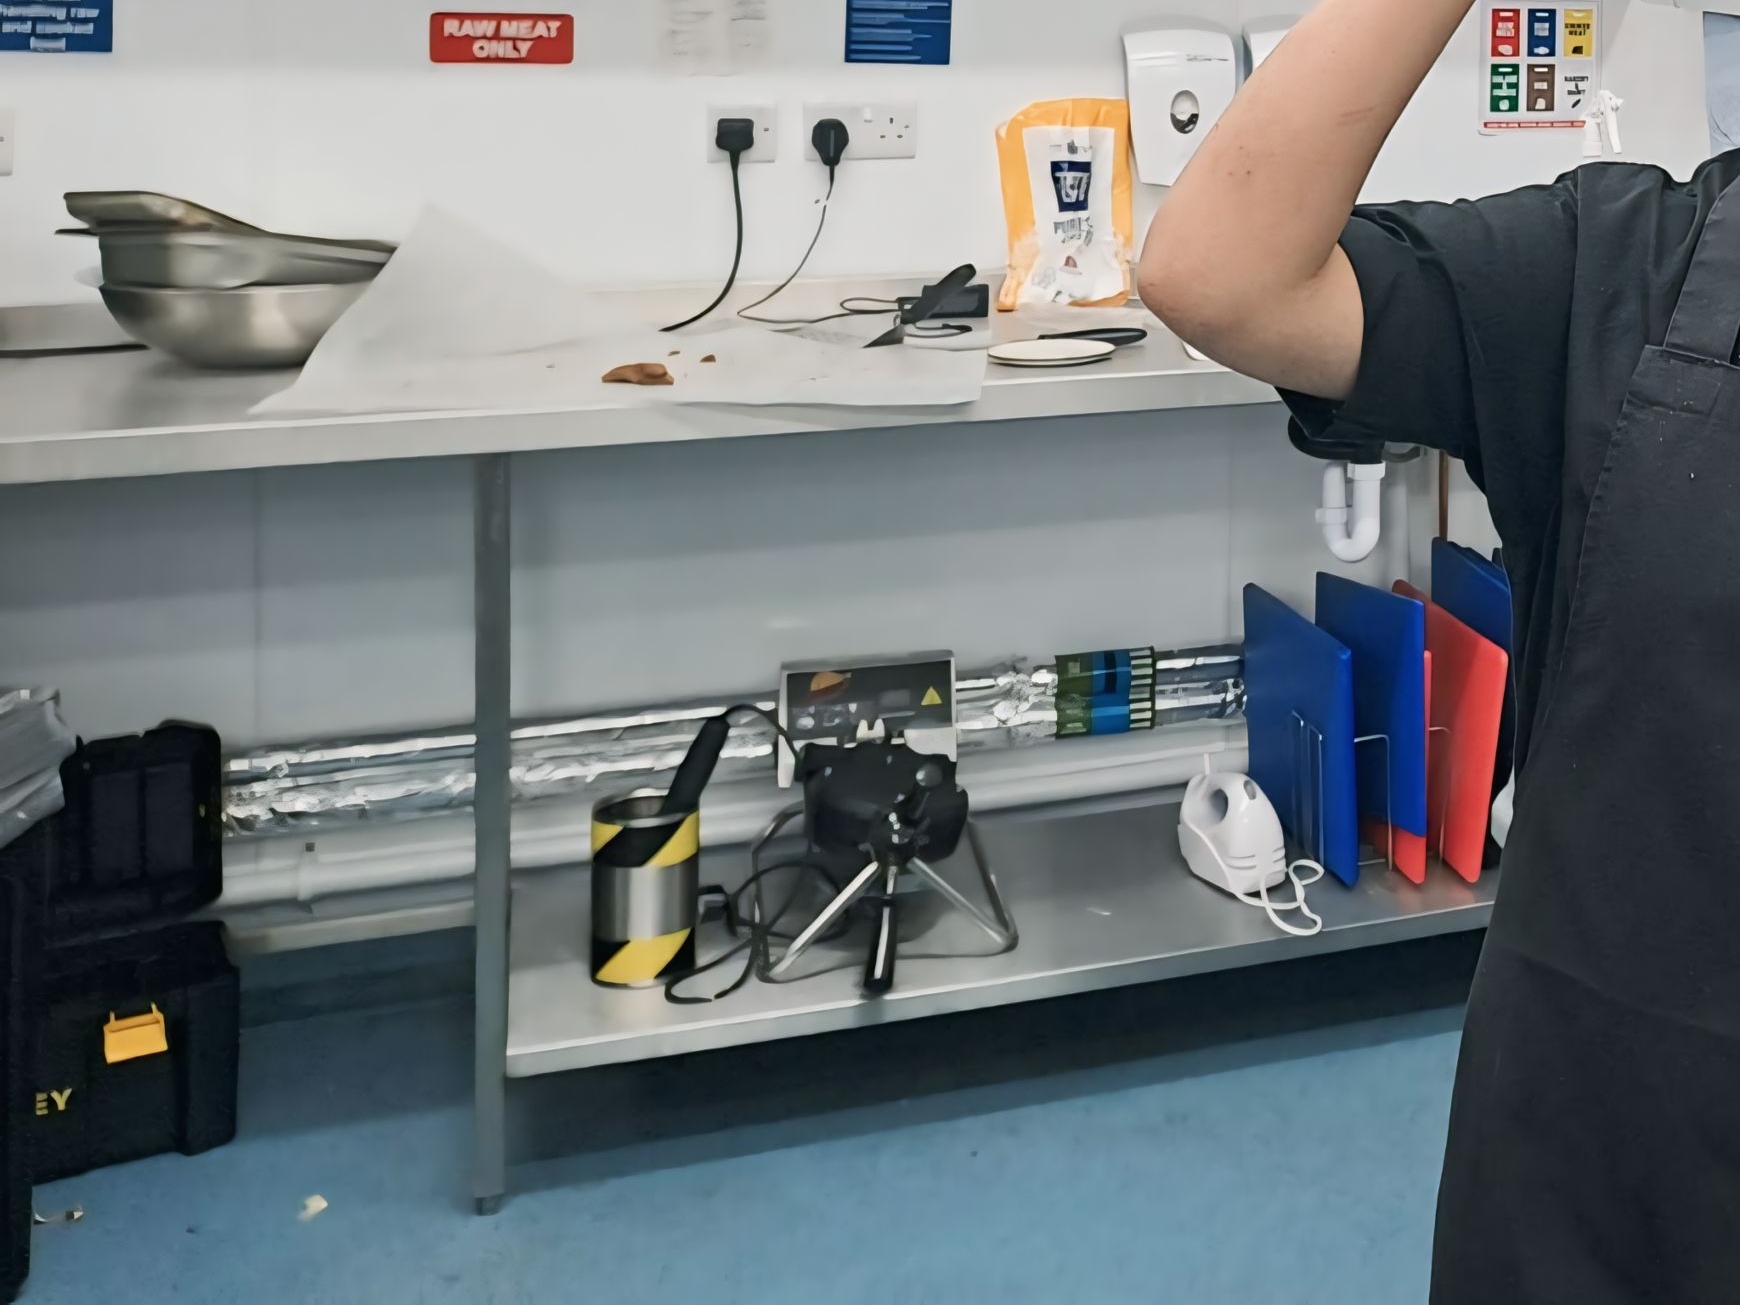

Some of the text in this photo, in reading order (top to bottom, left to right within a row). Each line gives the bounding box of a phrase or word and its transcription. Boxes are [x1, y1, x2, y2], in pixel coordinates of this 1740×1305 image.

[443, 18, 562, 39] RAW MEAT
[471, 38, 535, 59] ONLY
